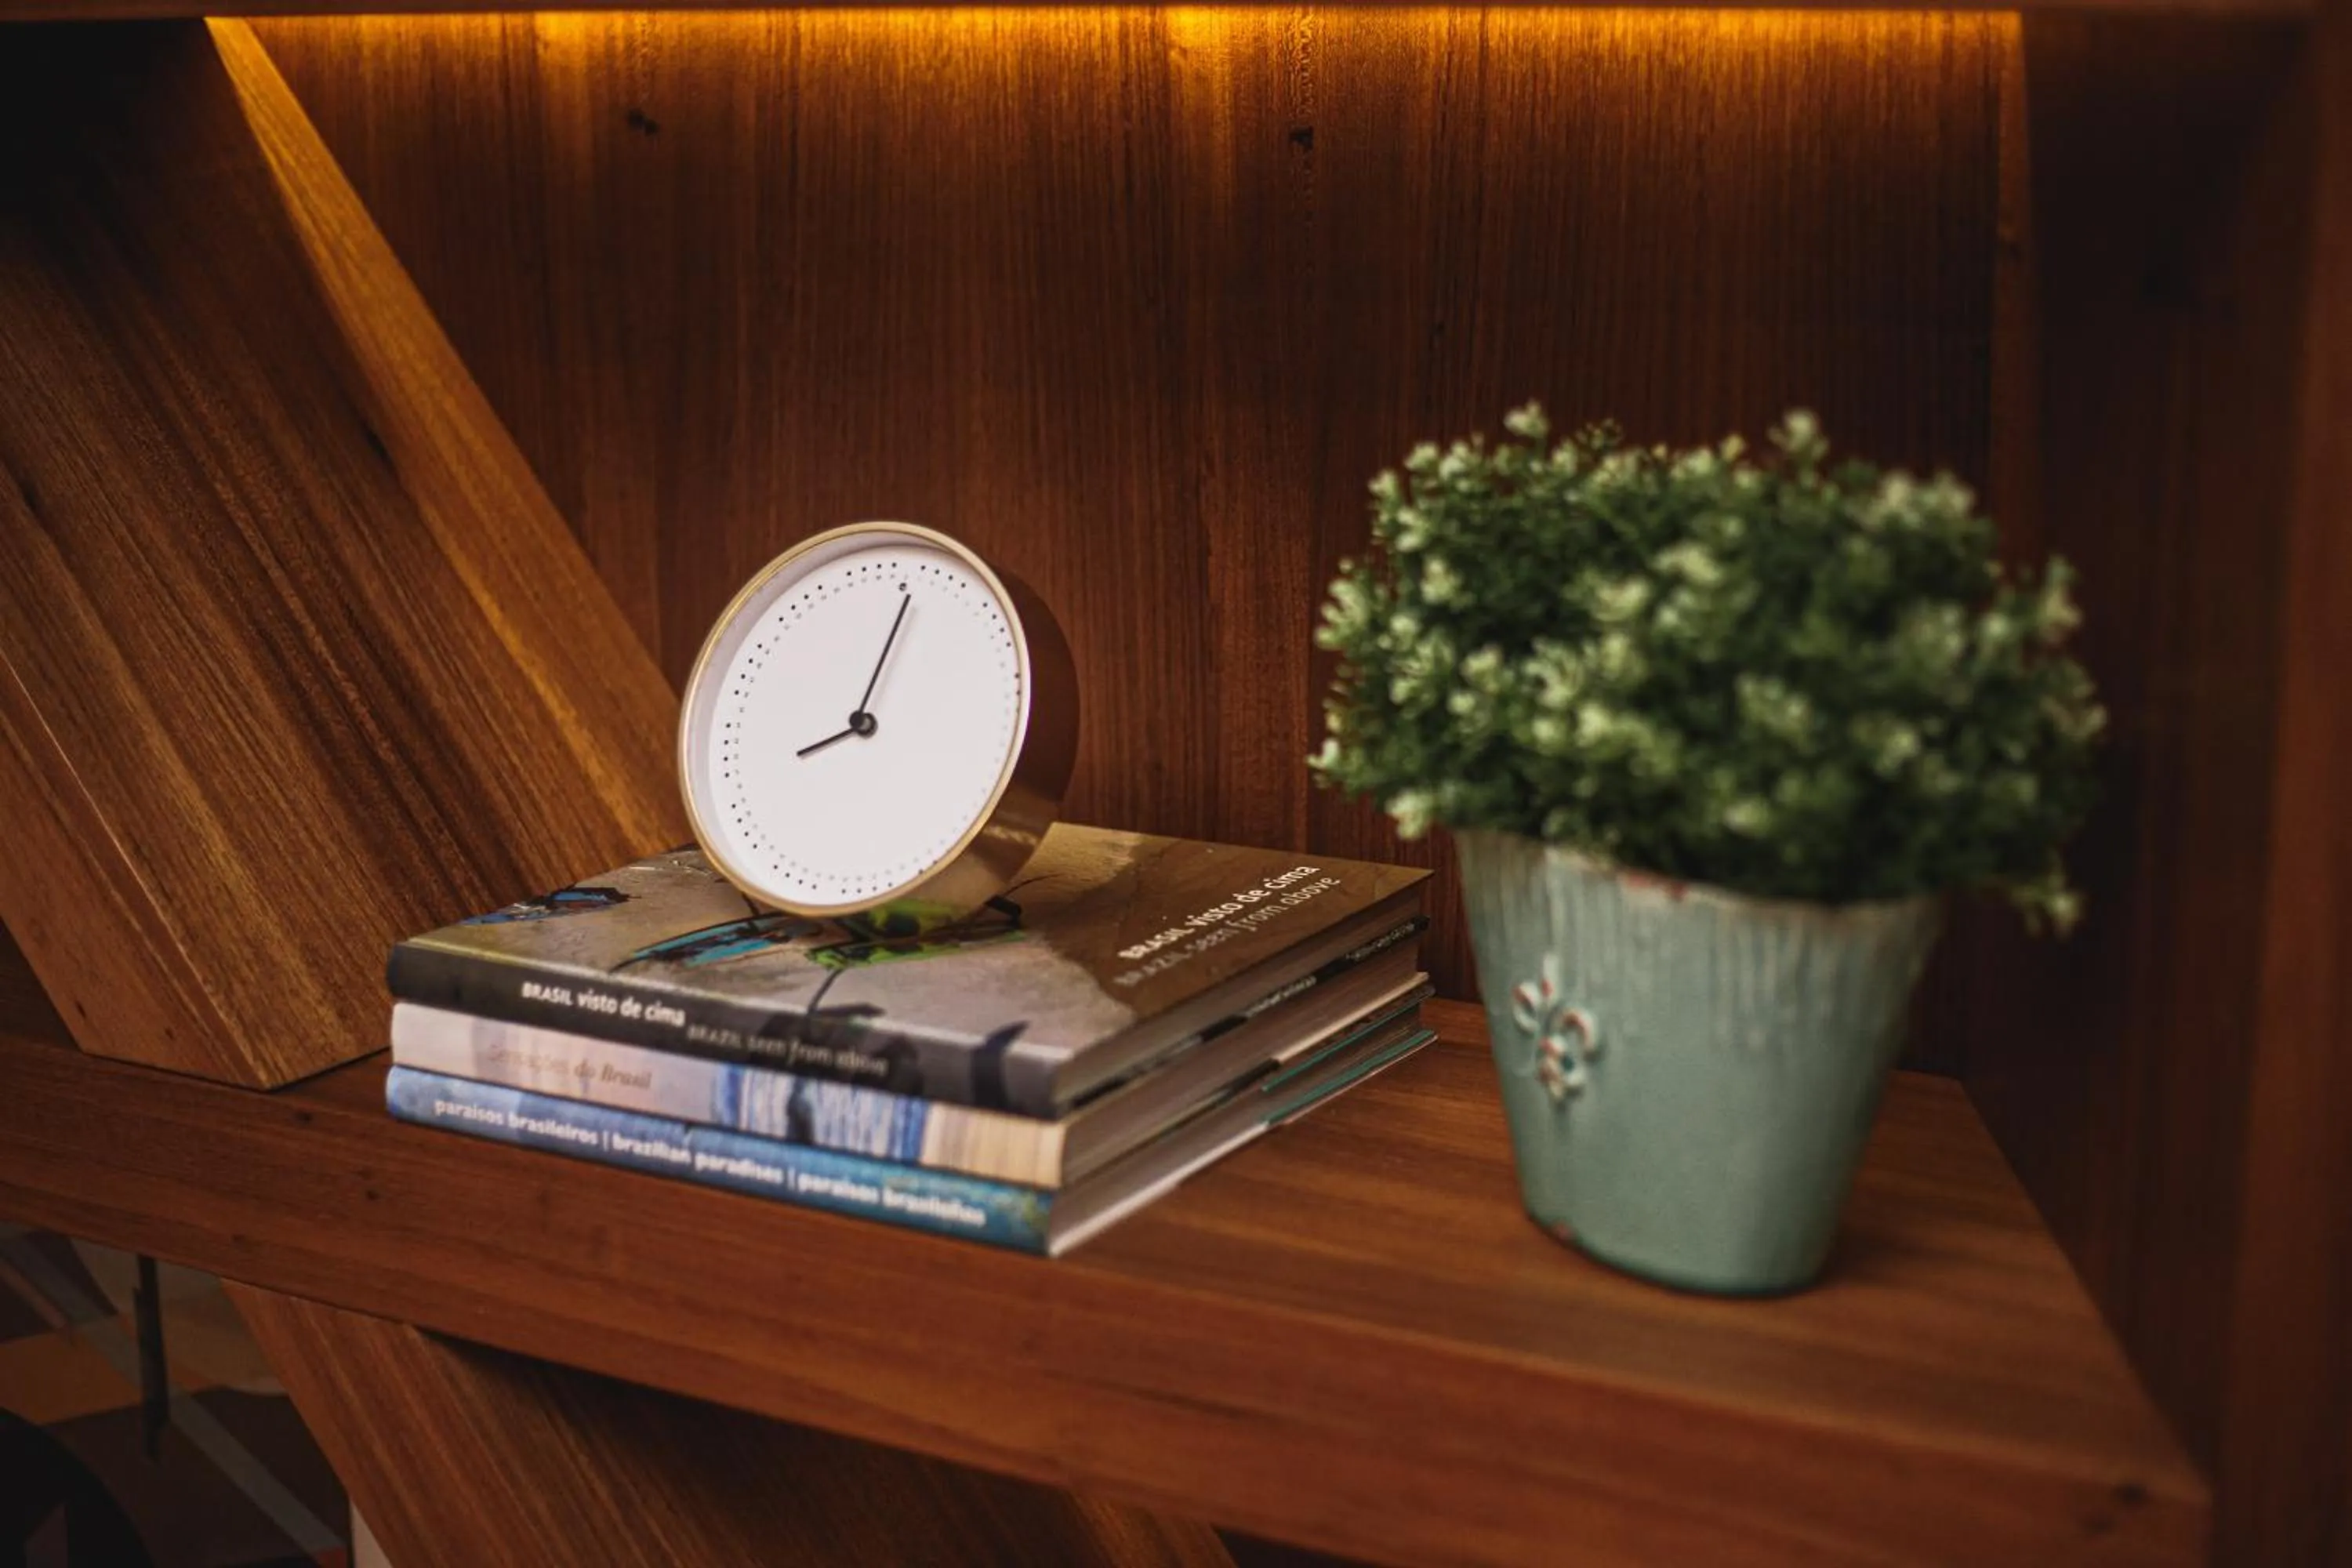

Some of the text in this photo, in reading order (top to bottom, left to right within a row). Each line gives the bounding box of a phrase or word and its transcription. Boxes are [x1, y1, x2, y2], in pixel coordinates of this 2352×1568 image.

[1184, 903, 1244, 926] visto
[1232, 889, 1272, 902] de
[1263, 866, 1320, 889] cima
[1185, 927, 1240, 951] seen
[1224, 905, 1290, 931] from
[1279, 877, 1341, 906] above
[521, 982, 686, 1027] BRASIL visto de cima
[687, 1025, 742, 1050] BRAZIL
[789, 1036, 833, 1067] from
[507, 1111, 598, 1145] brasileiros
[612, 1131, 691, 1163] brazilian
